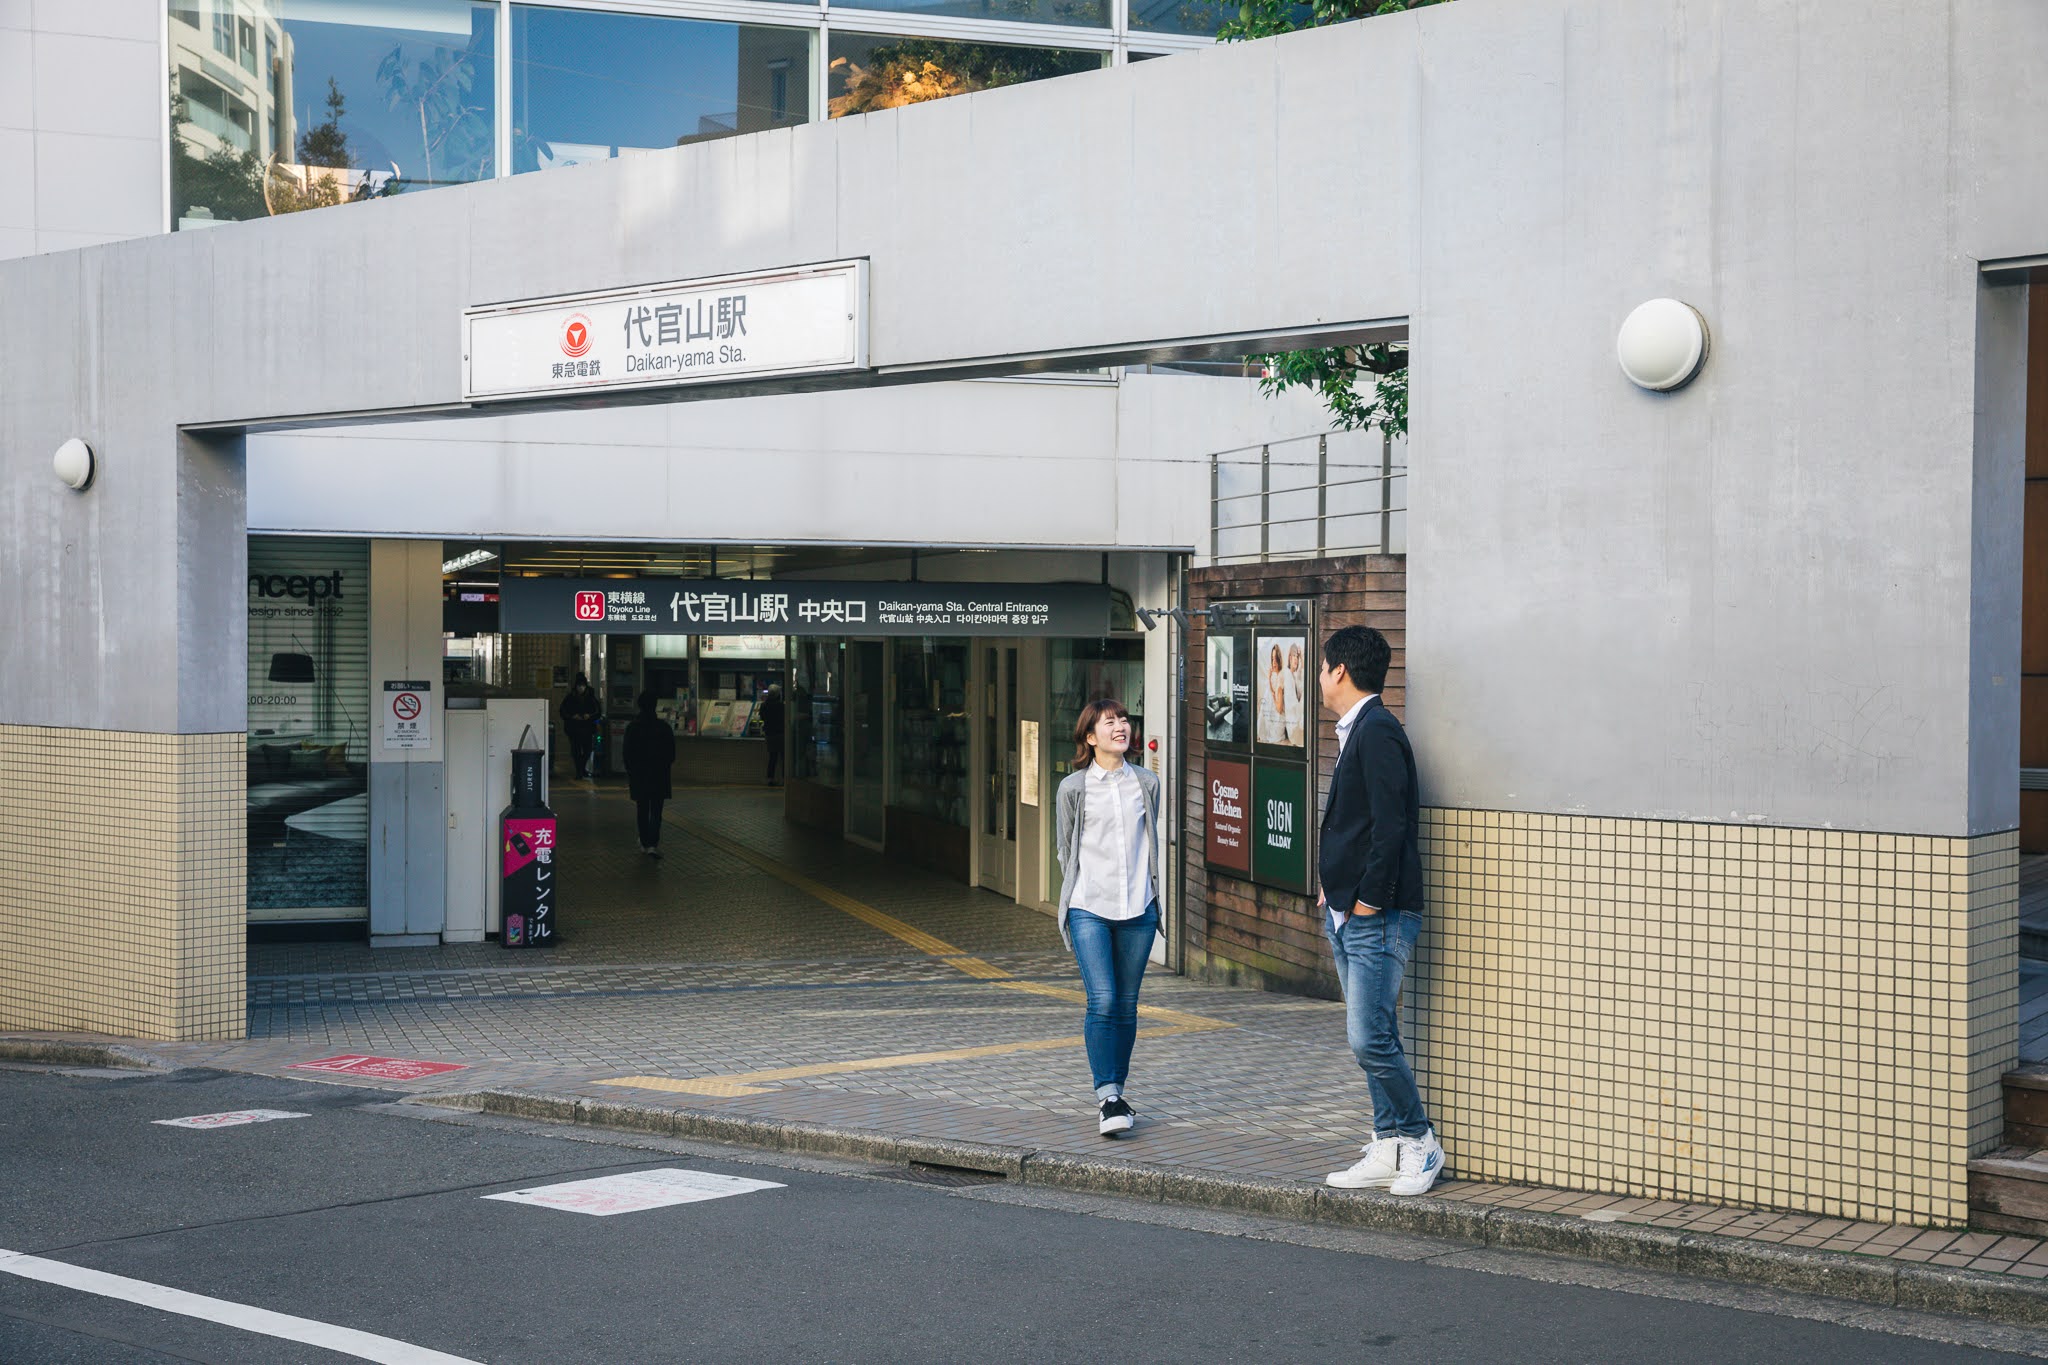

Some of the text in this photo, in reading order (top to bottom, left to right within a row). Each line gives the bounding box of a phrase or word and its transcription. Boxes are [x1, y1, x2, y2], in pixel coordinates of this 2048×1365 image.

[623, 294, 747, 350] 代官山駅
[626, 344, 747, 373] Daikan-yama Sta.
[552, 360, 601, 379] 東急電鉄
[248, 570, 344, 607] ncept
[607, 591, 645, 604] 東横線
[583, 594, 597, 604] TY
[670, 592, 866, 623] 代官山駅 中央口
[878, 600, 1049, 613] Daikan-yama Sta. Central Entrance
[284, 605, 314, 616] since
[580, 604, 600, 618] 02
[607, 605, 651, 614] Toyoko Line
[879, 614, 951, 624] 代官山站 中央入口
[247, 695, 297, 705] :00-20:00
[1212, 779, 1239, 800] Cosme
[1212, 797, 1243, 819] Kitchen
[1267, 799, 1293, 834] SIGN
[1267, 833, 1292, 850] ALLDAY
[534, 828, 551, 938] 充電レンタル
